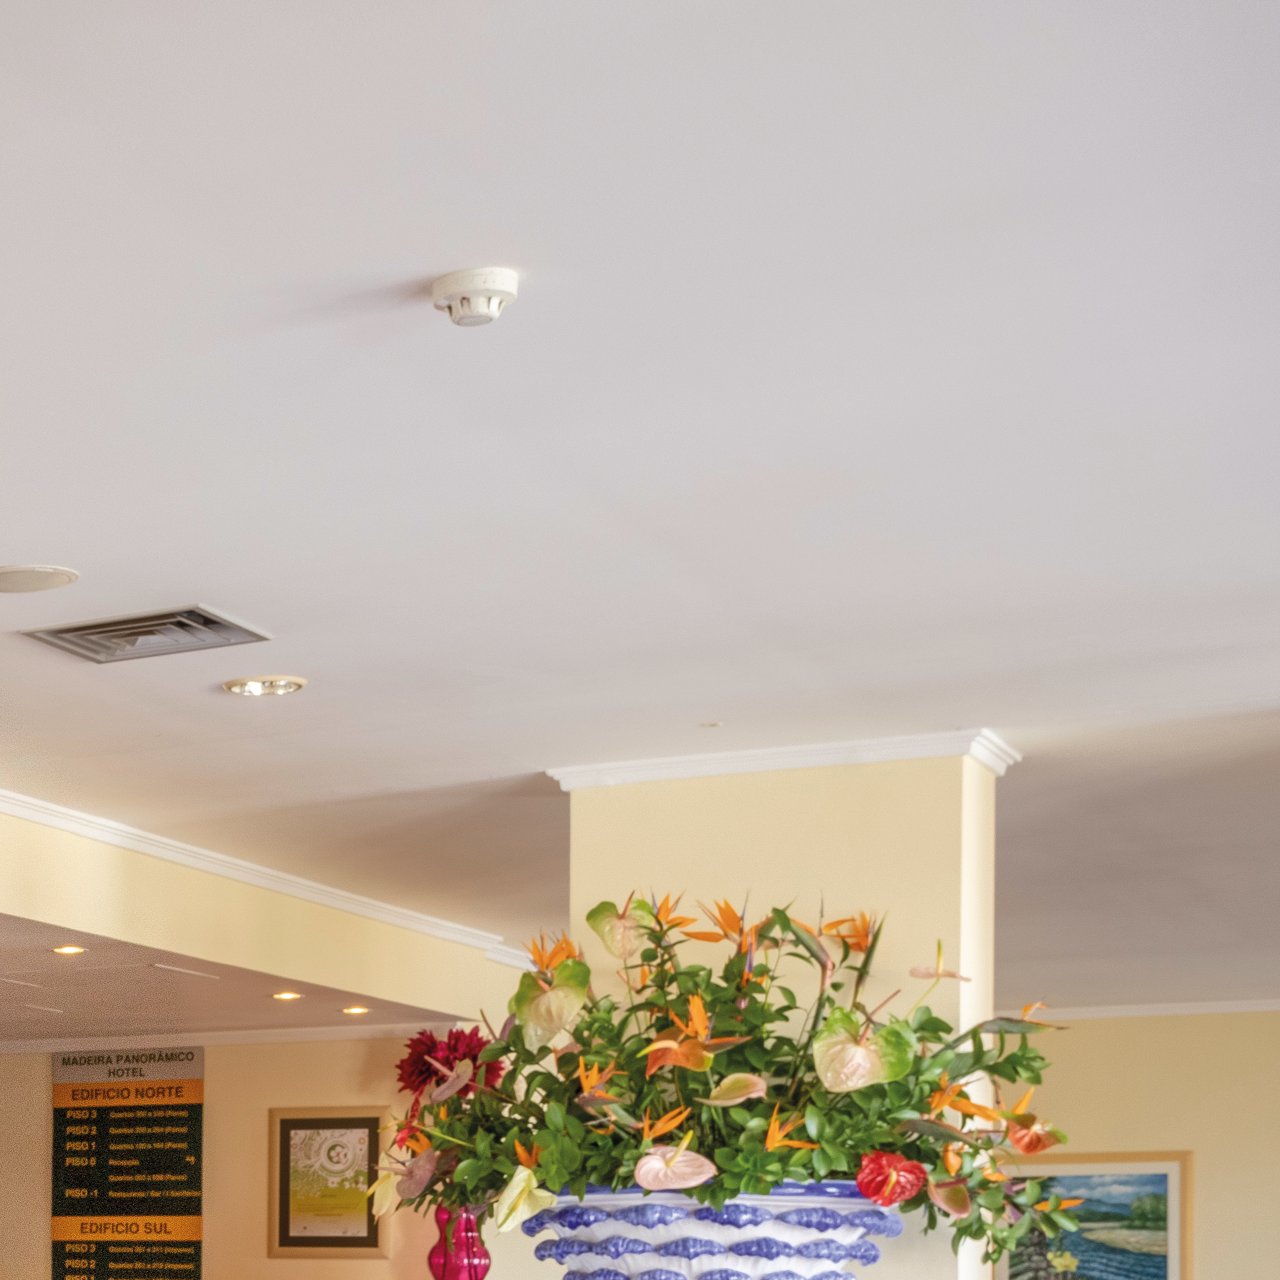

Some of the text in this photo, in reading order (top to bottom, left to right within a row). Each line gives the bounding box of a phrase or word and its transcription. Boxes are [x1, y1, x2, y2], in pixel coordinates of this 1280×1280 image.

[62, 1051, 194, 1066] MADEIRA PANORÂMICO
[108, 1068, 144, 1078] HOTEL
[72, 1086, 184, 1101] EDIFICIO NORTE
[66, 1110, 88, 1119] PISO
[91, 1110, 97, 1119] 3
[66, 1126, 88, 1135] PISO
[91, 1126, 97, 1135] 2
[66, 1142, 88, 1150] PISO
[91, 1142, 96, 1150] 1
[65, 1157, 88, 1166] PISO
[91, 1157, 96, 1166] 0
[65, 1188, 88, 1198] PISO
[90, 1189, 98, 1198] -1
[80, 1222, 172, 1235] EDIFICIO SUL
[64, 1243, 88, 1253] PISO
[90, 1243, 96, 1253] 3
[64, 1259, 88, 1269] PISO
[90, 1259, 96, 1269] 2
